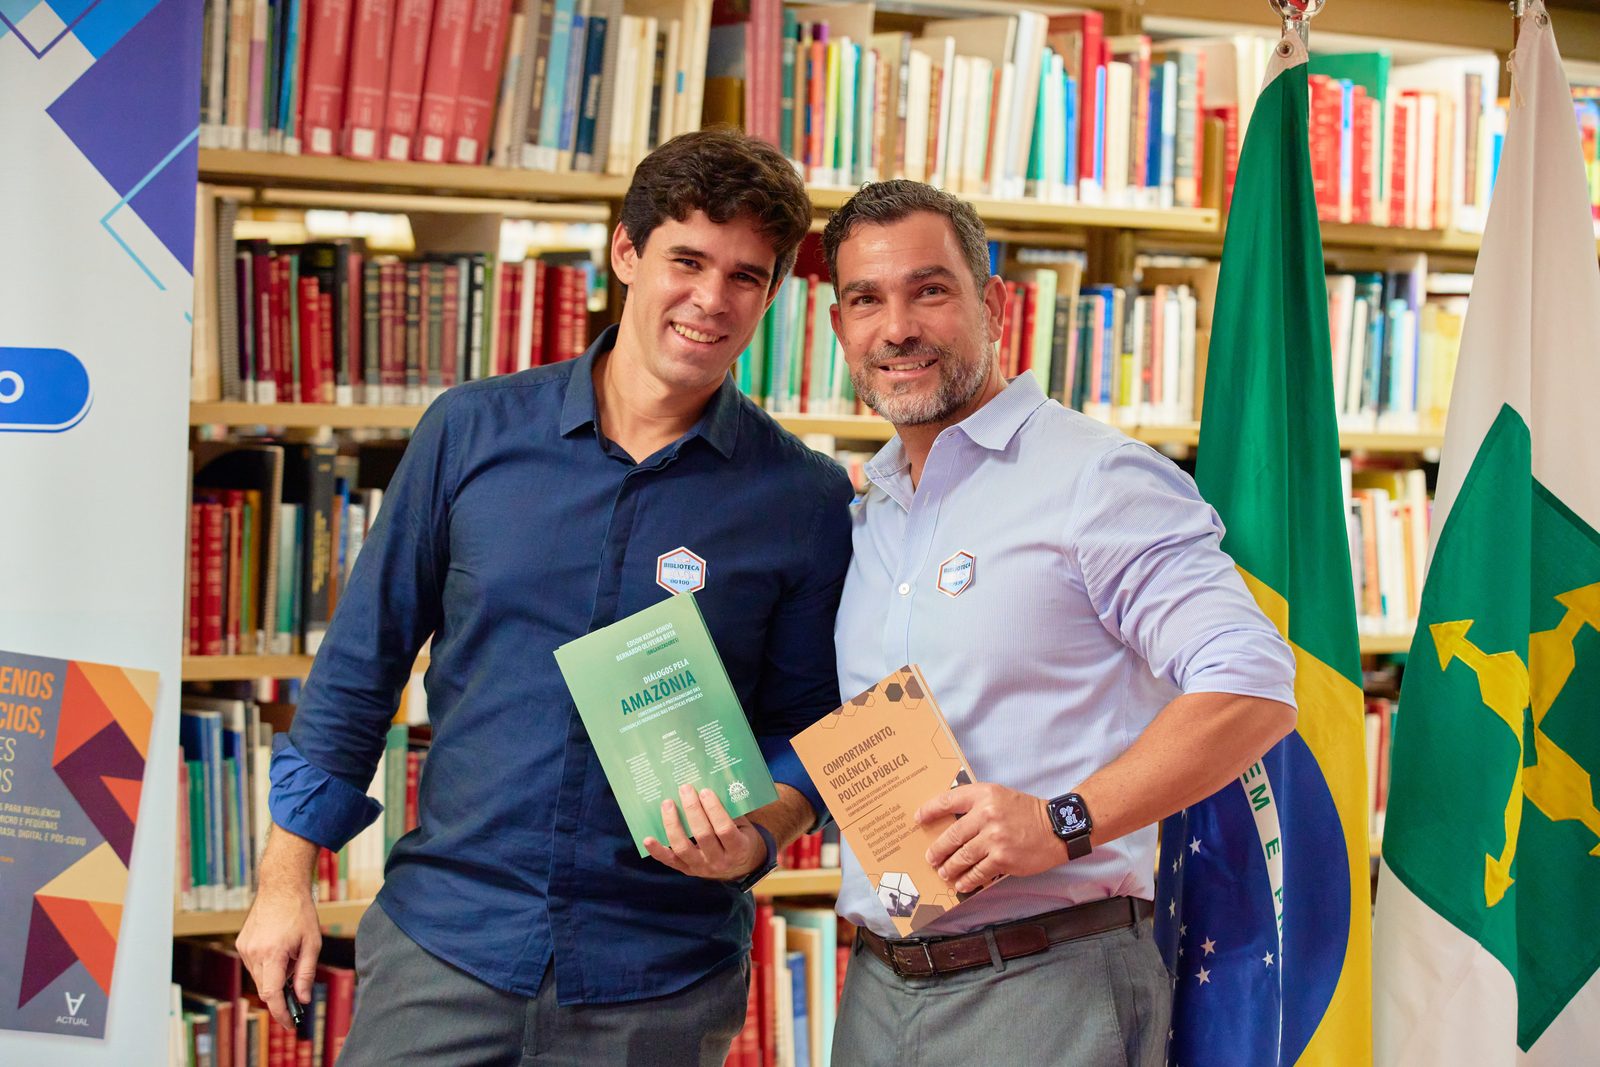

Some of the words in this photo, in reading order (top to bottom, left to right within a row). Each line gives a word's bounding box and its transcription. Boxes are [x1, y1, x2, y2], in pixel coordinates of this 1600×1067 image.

[664, 562, 700, 571] BIBLIOTECA
[616, 646, 642, 662] BERNARDO
[642, 635, 664, 650] OLIVEIRA
[643, 664, 673, 684] DIÁLOGOS
[673, 658, 689, 670] PELA
[620, 670, 697, 715] AMAZÔNIA
[823, 726, 896, 776] COMPORTAMENTO,
[830, 758, 872, 790] VIOLÊNCIA
[870, 754, 878, 764] E
[838, 775, 874, 804] POLÍTICA
[872, 754, 910, 782] PÚBLICA
[4, 803, 21, 813] PARA
[1265, 837, 1280, 860] E
[56, 1016, 89, 1026] ACTUAL
